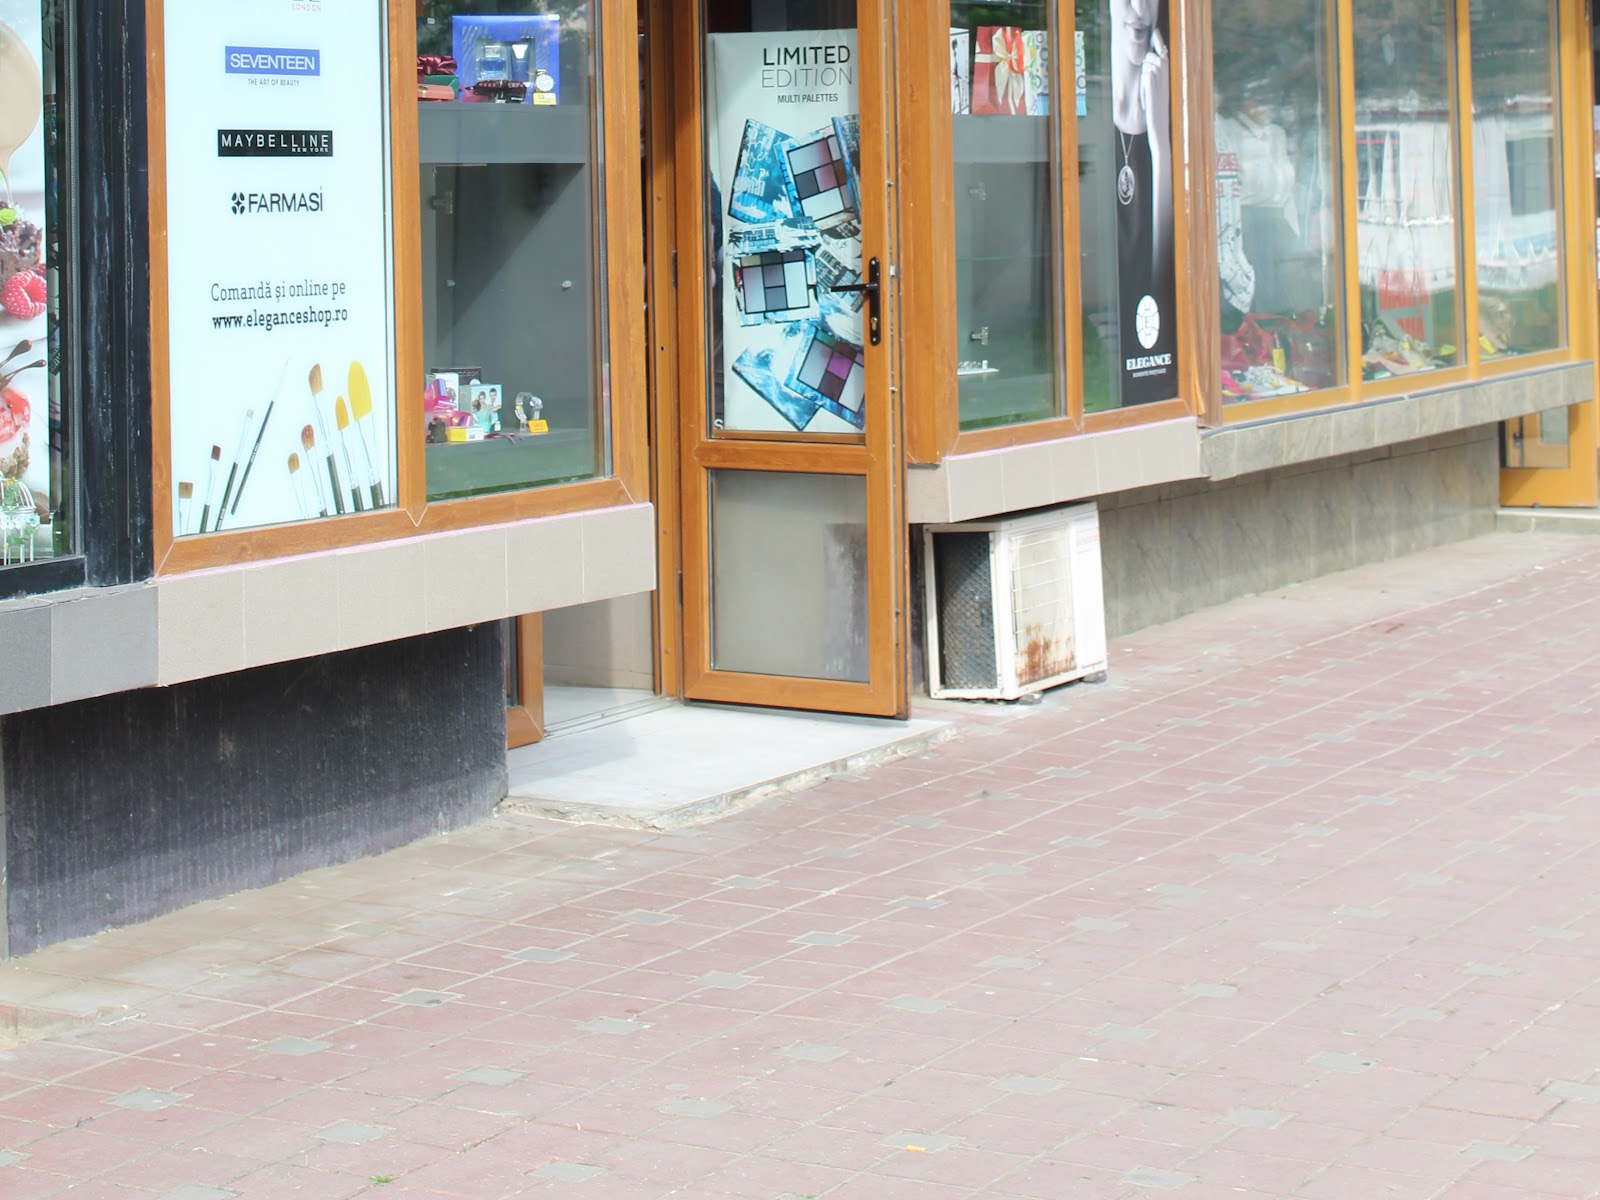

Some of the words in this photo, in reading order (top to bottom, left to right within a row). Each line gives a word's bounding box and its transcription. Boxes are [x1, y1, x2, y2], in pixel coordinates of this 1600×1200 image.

[292, 3, 321, 12] LONDON
[230, 53, 315, 71] SEVENTEEN
[763, 45, 851, 66] LIMITED
[248, 78, 258, 86] THE
[260, 78, 270, 86] ART
[280, 79, 300, 87] BEAUTY
[761, 66, 853, 88] EDITION
[777, 94, 800, 104] MULTI
[802, 93, 838, 103] PALETTES
[221, 134, 329, 148] MAYBELLINE
[211, 280, 273, 302] Comandă
[289, 279, 329, 297] online
[332, 282, 346, 300] pe
[212, 305, 348, 332] www.eleganceshop.ro
[1126, 353, 1172, 371] ELEGANCE
